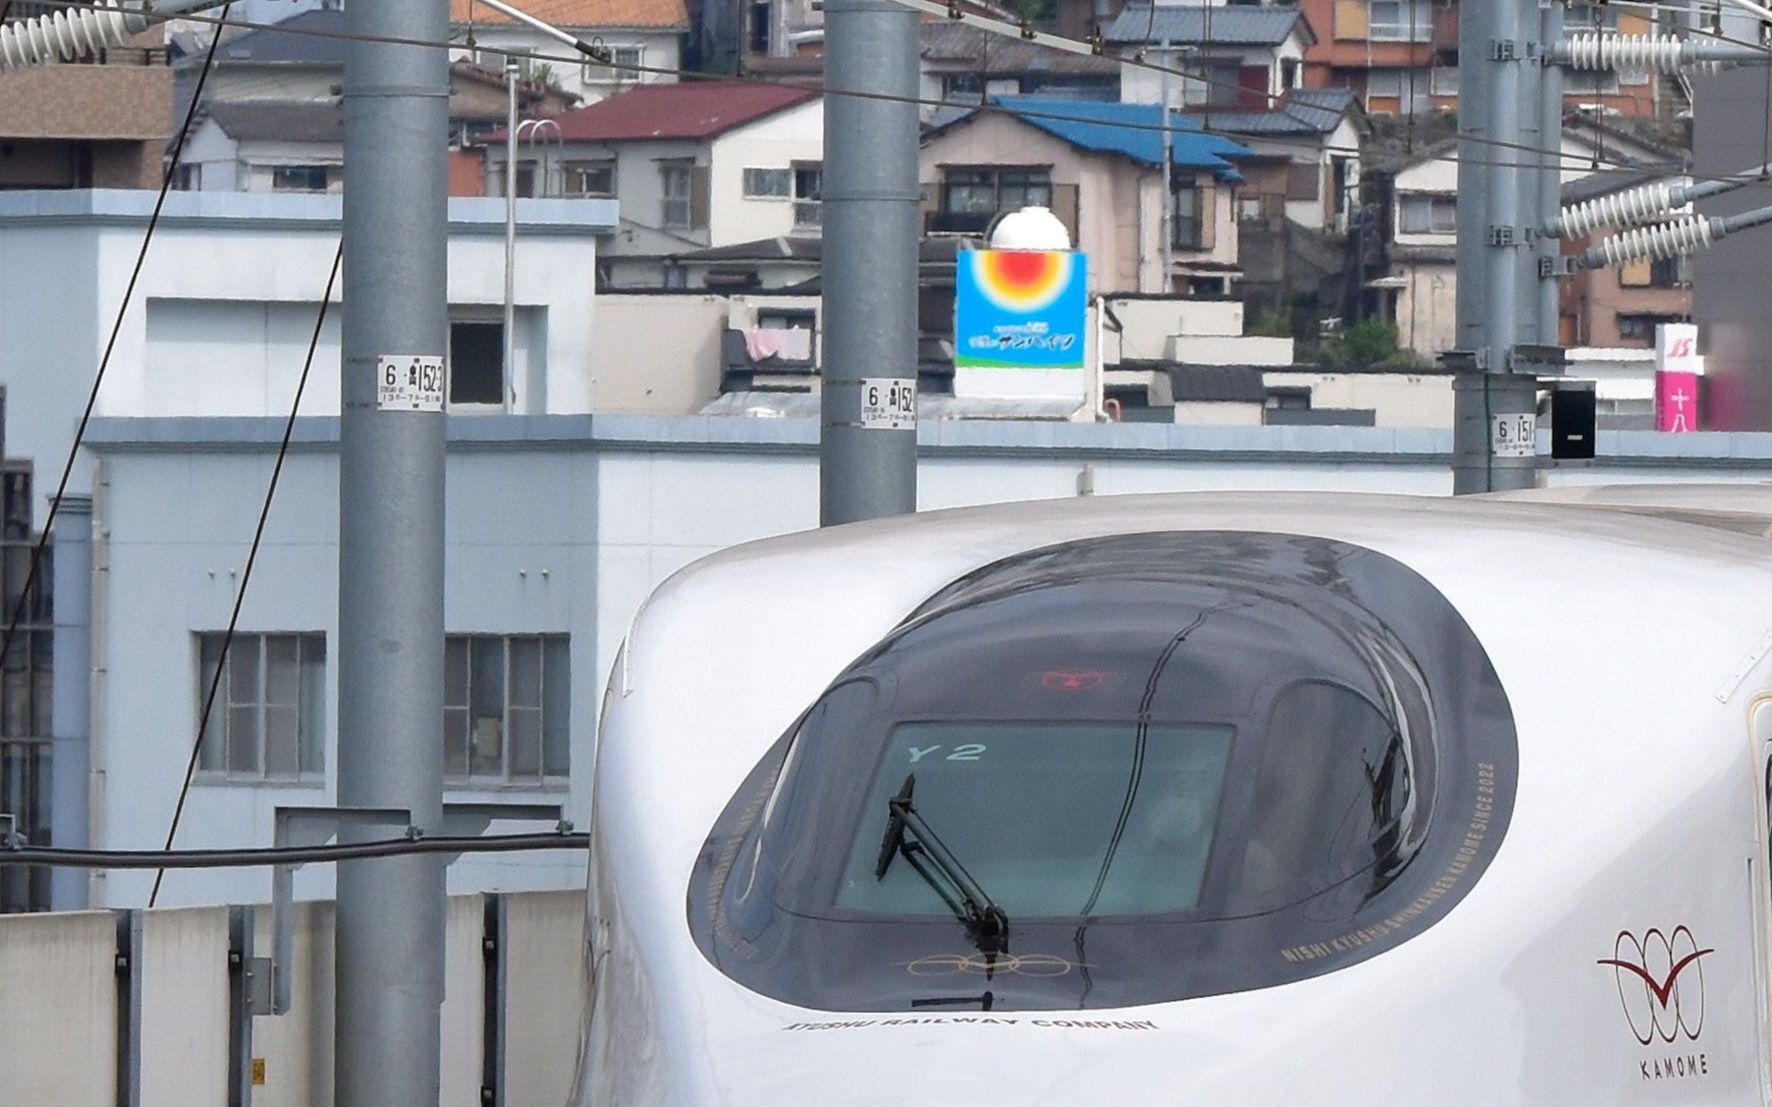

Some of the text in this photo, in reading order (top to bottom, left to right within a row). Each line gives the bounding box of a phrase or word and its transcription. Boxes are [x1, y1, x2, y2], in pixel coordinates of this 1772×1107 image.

[386, 364, 396, 385] 6
[869, 386, 878, 406] 6
[1499, 421, 1508, 437] 6
[1281, 943, 1332, 963] NISHI
[880, 1016, 1019, 1026] RAILWAY
[1031, 1019, 1161, 1030] COMPANY
[1640, 1054, 1707, 1080] KAMOME
